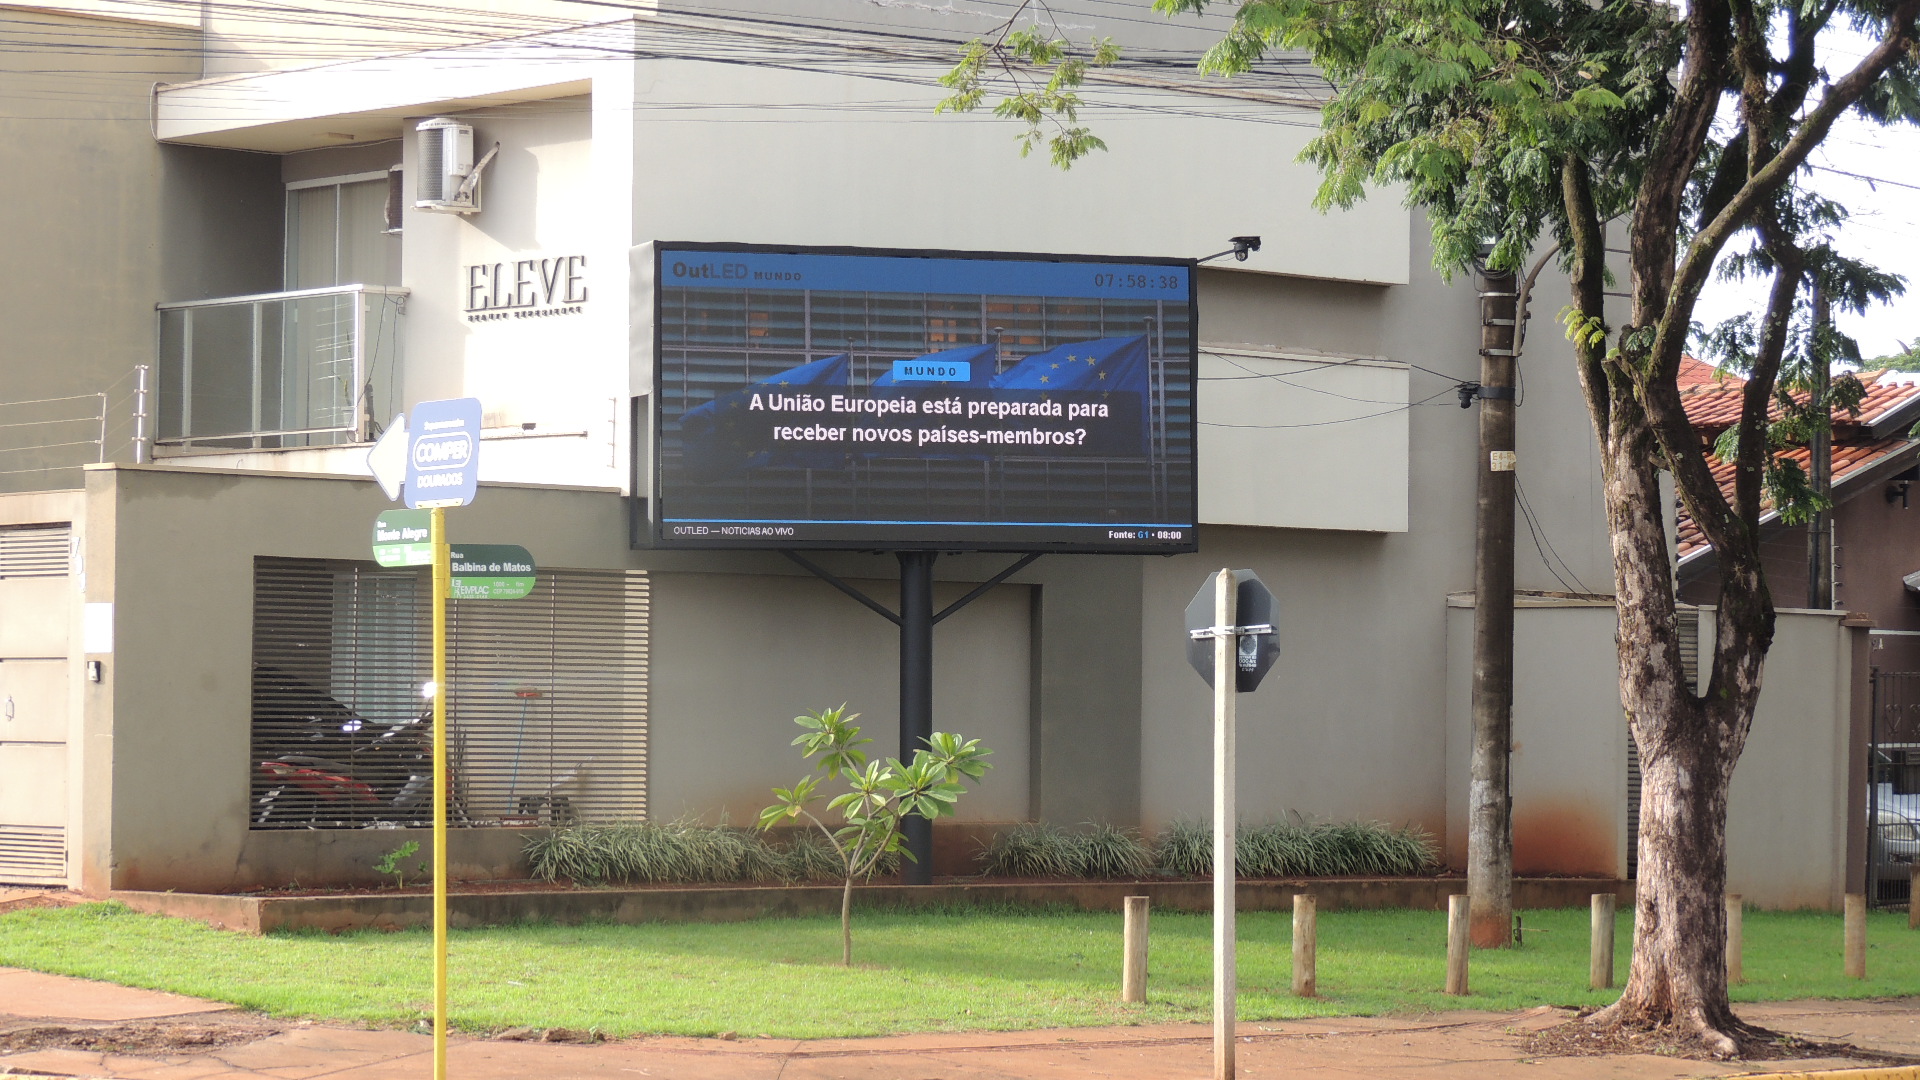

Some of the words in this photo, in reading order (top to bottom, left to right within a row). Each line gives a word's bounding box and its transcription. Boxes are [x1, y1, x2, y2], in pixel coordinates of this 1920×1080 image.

[672, 261, 748, 279] OutLED
[754, 272, 802, 281] MUNDO
[463, 255, 588, 312] ELEVE
[1095, 273, 1178, 289] 07:58:38
[904, 366, 957, 376] MUNDO
[749, 393, 764, 411] A
[768, 393, 826, 412] União
[831, 394, 917, 418] Europeia
[922, 396, 962, 415] está
[968, 399, 1063, 419] preparada
[1068, 403, 1109, 421] para
[773, 423, 847, 441] receber
[852, 427, 912, 442] novos
[918, 424, 1087, 447] países-membros?
[416, 439, 468, 463] COMPER
[673, 526, 709, 535] OUTLED
[721, 527, 761, 536] NOTICIAS
[761, 527, 774, 536] AO
[775, 527, 794, 536] VIVO
[1108, 530, 1136, 539] Fonte:
[1137, 530, 1149, 539] G1
[1157, 531, 1181, 540] 08:00
[450, 551, 464, 559] Rua
[452, 562, 487, 572] Balbina
[488, 562, 501, 572] de
[503, 562, 532, 572] Matos
